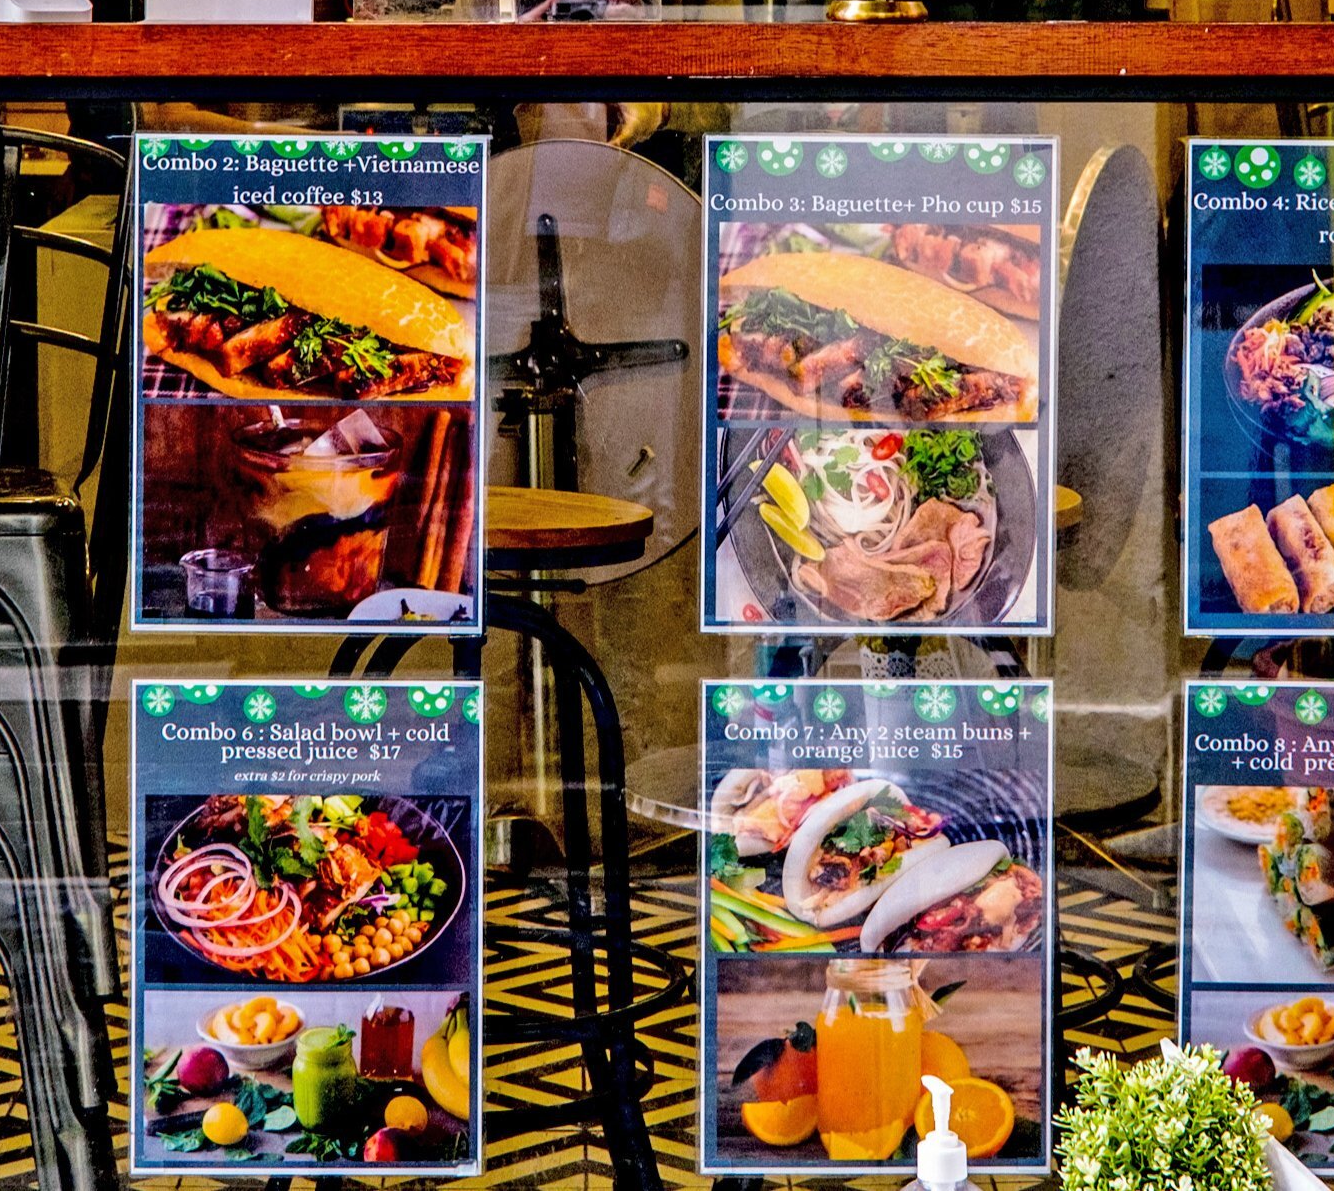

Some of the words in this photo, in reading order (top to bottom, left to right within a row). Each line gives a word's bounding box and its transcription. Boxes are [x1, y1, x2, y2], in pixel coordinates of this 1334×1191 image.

[143, 154, 217, 171] Combo
[223, 157, 239, 171] 2:
[245, 157, 338, 177] Baguette
[343, 157, 479, 173] +Vietnamese
[233, 185, 275, 204] iced
[281, 185, 345, 205] coffee
[351, 189, 383, 206] $13
[710, 193, 783, 213] Combo
[789, 197, 806, 212] 3:
[811, 195, 916, 217] Baguette+
[921, 194, 961, 214] Pho
[966, 200, 1005, 218] cup
[1010, 197, 1042, 215] $15
[1193, 193, 1267, 212] Combo
[1272, 196, 1290, 211] 4:
[161, 721, 237, 741] Combo
[241, 726, 254, 741] 6
[269, 721, 327, 744] Salad
[330, 722, 383, 742] bowl
[405, 722, 450, 742] cold
[724, 724, 798, 741] Combo
[804, 727, 814, 741] 7
[832, 725, 869, 745] Any
[877, 727, 889, 741] 2
[894, 726, 957, 741] steam
[963, 724, 1013, 741] buns
[1195, 733, 1269, 752] Combo
[1275, 737, 1285, 752] 8
[220, 742, 303, 764] pressed
[304, 742, 358, 766] juice
[369, 743, 401, 761] $17
[792, 744, 863, 763] orange
[868, 741, 919, 763] juice
[931, 743, 963, 759] $15
[1250, 752, 1293, 771] cold
[234, 771, 268, 782] extra
[270, 771, 286, 782] $2
[287, 769, 308, 782] for
[309, 769, 350, 785] crispy
[350, 769, 382, 785] pork
